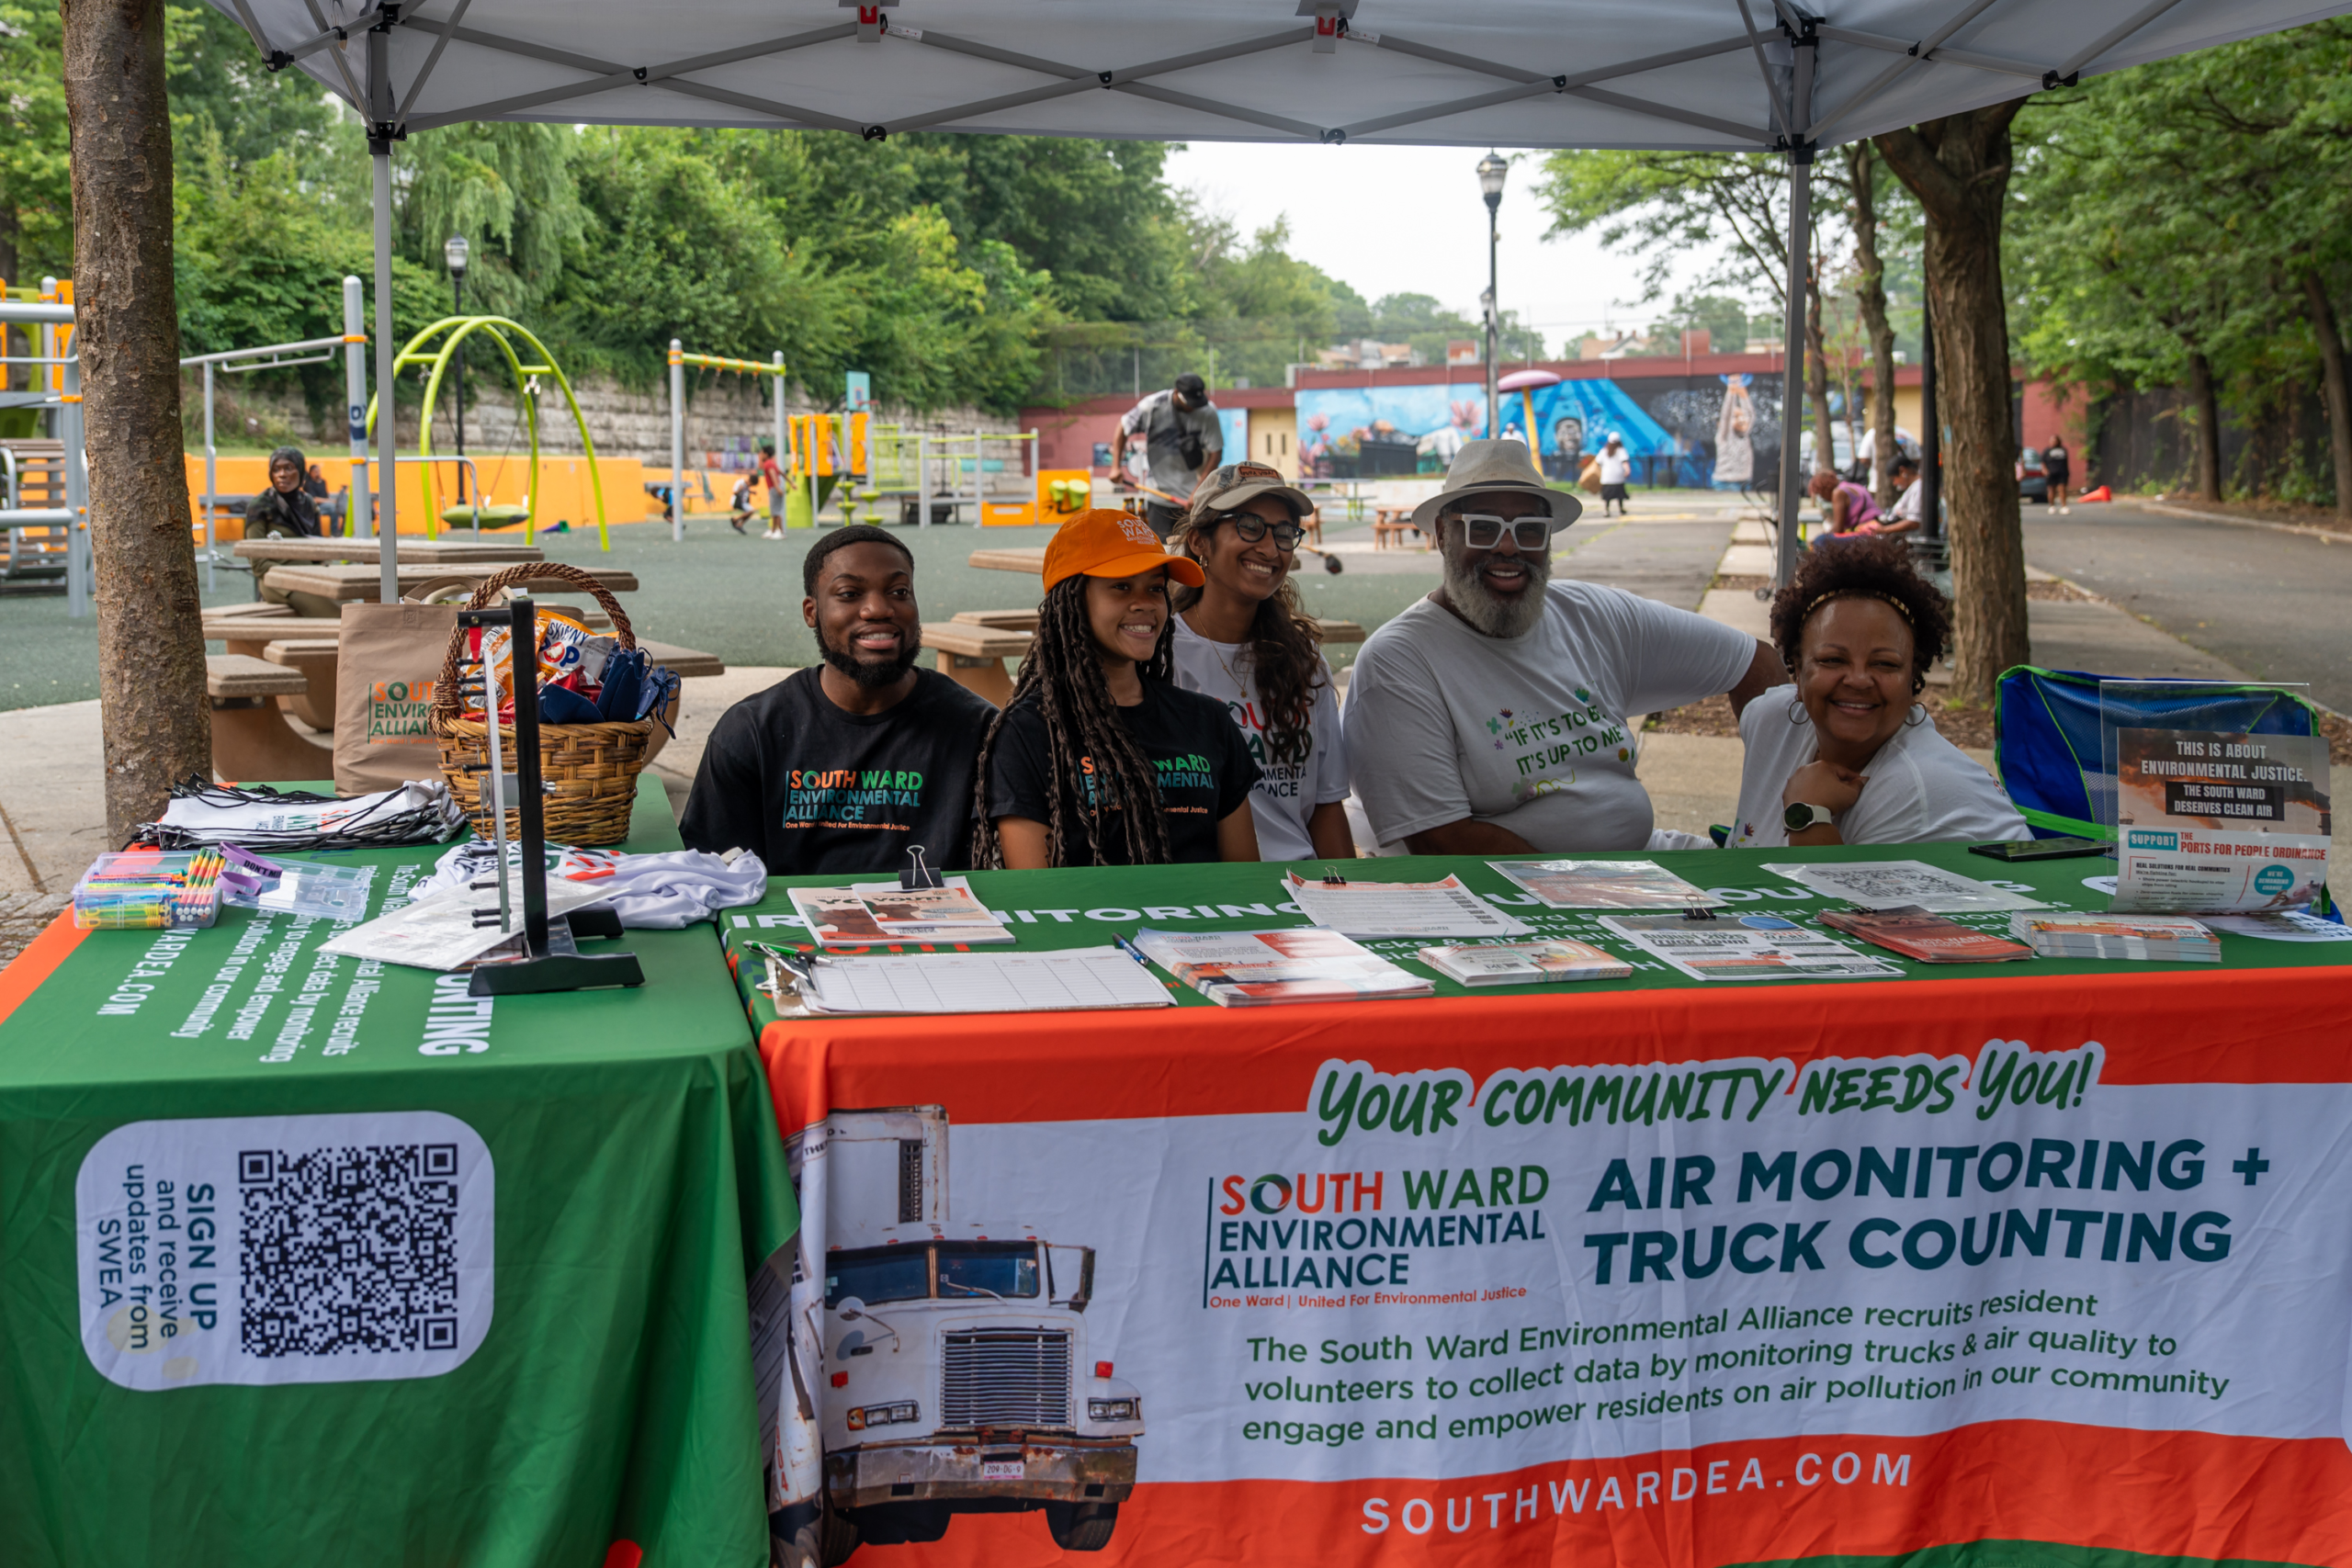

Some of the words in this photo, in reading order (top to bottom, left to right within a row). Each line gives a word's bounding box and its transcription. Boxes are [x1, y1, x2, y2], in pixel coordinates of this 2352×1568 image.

[1122, 526, 1155, 539] WARD
[547, 622, 590, 647] SKINNY
[374, 682, 435, 702] SOUT
[1530, 718, 1561, 740] IT'S
[1561, 711, 1587, 730] TO
[1152, 754, 1211, 773] WARD
[1516, 751, 1547, 775] IT'S
[1547, 744, 1570, 765] UP
[1572, 736, 1598, 756] TO
[2177, 741, 2204, 756] THIS
[2209, 742, 2222, 757] IS
[2225, 743, 2267, 760] ABOUT
[790, 770, 856, 790] SOUTH
[861, 770, 923, 790] WARD
[2142, 760, 2247, 779] ENVIRONMENTAL
[2251, 765, 2308, 783] JUSTICE.
[789, 789, 921, 807] ENVIRONMENTAL
[2184, 784, 2201, 796] THE
[2203, 785, 2234, 799] SOUTH
[2236, 786, 2266, 800] WARD
[786, 805, 865, 821] ALLIANCE
[2174, 800, 2222, 816] DESERVES
[2223, 803, 2254, 817] CLEAN
[2256, 805, 2273, 817] AIR
[2131, 833, 2176, 847] SUPPORT
[2180, 832, 2193, 840] THE
[2180, 841, 2211, 854] PORTS
[2213, 843, 2232, 856] FOR
[2234, 844, 2269, 858] PEOPLE
[2272, 847, 2326, 861] ORDINANCE
[243, 859, 269, 876] DON'T
[397, 864, 421, 874] The
[2197, 865, 2231, 874] COMMUNITIES
[387, 873, 418, 896] South
[231, 919, 273, 955] pollution
[284, 930, 312, 941] to
[224, 955, 257, 965] in
[263, 941, 301, 974] engage
[214, 965, 243, 982] our
[254, 974, 285, 993] and
[301, 971, 339, 993] data
[169, 983, 232, 1039] community
[289, 992, 330, 1006] by
[339, 977, 381, 1016] Alliance
[226, 994, 274, 1041] empower
[259, 1007, 315, 1063] monitoring
[322, 1016, 361, 1056] recruits
[1317, 1068, 1464, 1147] YOUR
[1483, 1067, 1785, 1127] COMMUNITY
[1798, 1064, 1963, 1116] NEEDS
[1976, 1048, 2095, 1122] YOU!
[1219, 1170, 1385, 1217] SOUTH
[1402, 1164, 1551, 1211] WARD
[1586, 1154, 1717, 1213] AIR
[1736, 1137, 2206, 1204] MONITORING
[2233, 1146, 2270, 1187] +
[122, 1163, 152, 1275] updates
[155, 1179, 181, 1232] and
[187, 1182, 216, 1269] SIGN
[1218, 1210, 1546, 1253] ENVIRONMENTAL
[1583, 1219, 1831, 1286] TRUCK
[1848, 1207, 2233, 1271] COUNTING
[97, 1218, 123, 1310] SWEA
[1209, 1253, 1410, 1291] ALLIANCE
[157, 1241, 179, 1339] receive
[1209, 1295, 1241, 1308] One
[1245, 1293, 1284, 1307] Ward
[1298, 1293, 1347, 1308] United
[1350, 1293, 1370, 1306] For
[1374, 1288, 1477, 1305] Environmental
[1480, 1286, 1528, 1302] Justice
[130, 1283, 153, 1350] from
[189, 1281, 218, 1331] UP
[1246, 1336, 1308, 1363] The
[1319, 1334, 1413, 1365] South
[1425, 1328, 1510, 1361] Ward
[1519, 1307, 1728, 1353] Environmental
[1737, 1303, 1854, 1332] Alliance
[1863, 1300, 1973, 1329] recruits
[1978, 1289, 2098, 1318] resident
[1245, 1374, 1415, 1404] volunteers
[1426, 1376, 1459, 1401] to
[1469, 1360, 1565, 1398] collect
[1573, 1356, 1641, 1384] data
[1650, 1352, 1688, 1381] by
[1694, 1338, 1853, 1373] monitoring
[1864, 1337, 1956, 1364] trucks
[1961, 1331, 1978, 1358] &
[1983, 1326, 2019, 1352] air
[2027, 1328, 2138, 1360] quality
[2147, 1334, 2177, 1357] to
[1241, 1415, 1365, 1448] engage
[1375, 1414, 1438, 1439] and
[1447, 1400, 1588, 1438] empower
[1595, 1381, 1724, 1421] residents
[1733, 1384, 1770, 1404] on
[1779, 1376, 1817, 1402] air
[1825, 1374, 1957, 1404] pollution
[1962, 1366, 1984, 1393] in
[1990, 1359, 2041, 1385] our
[2050, 1366, 2231, 1401] community
[1361, 1451, 1912, 1536] SOUTHWARDEA.COM
